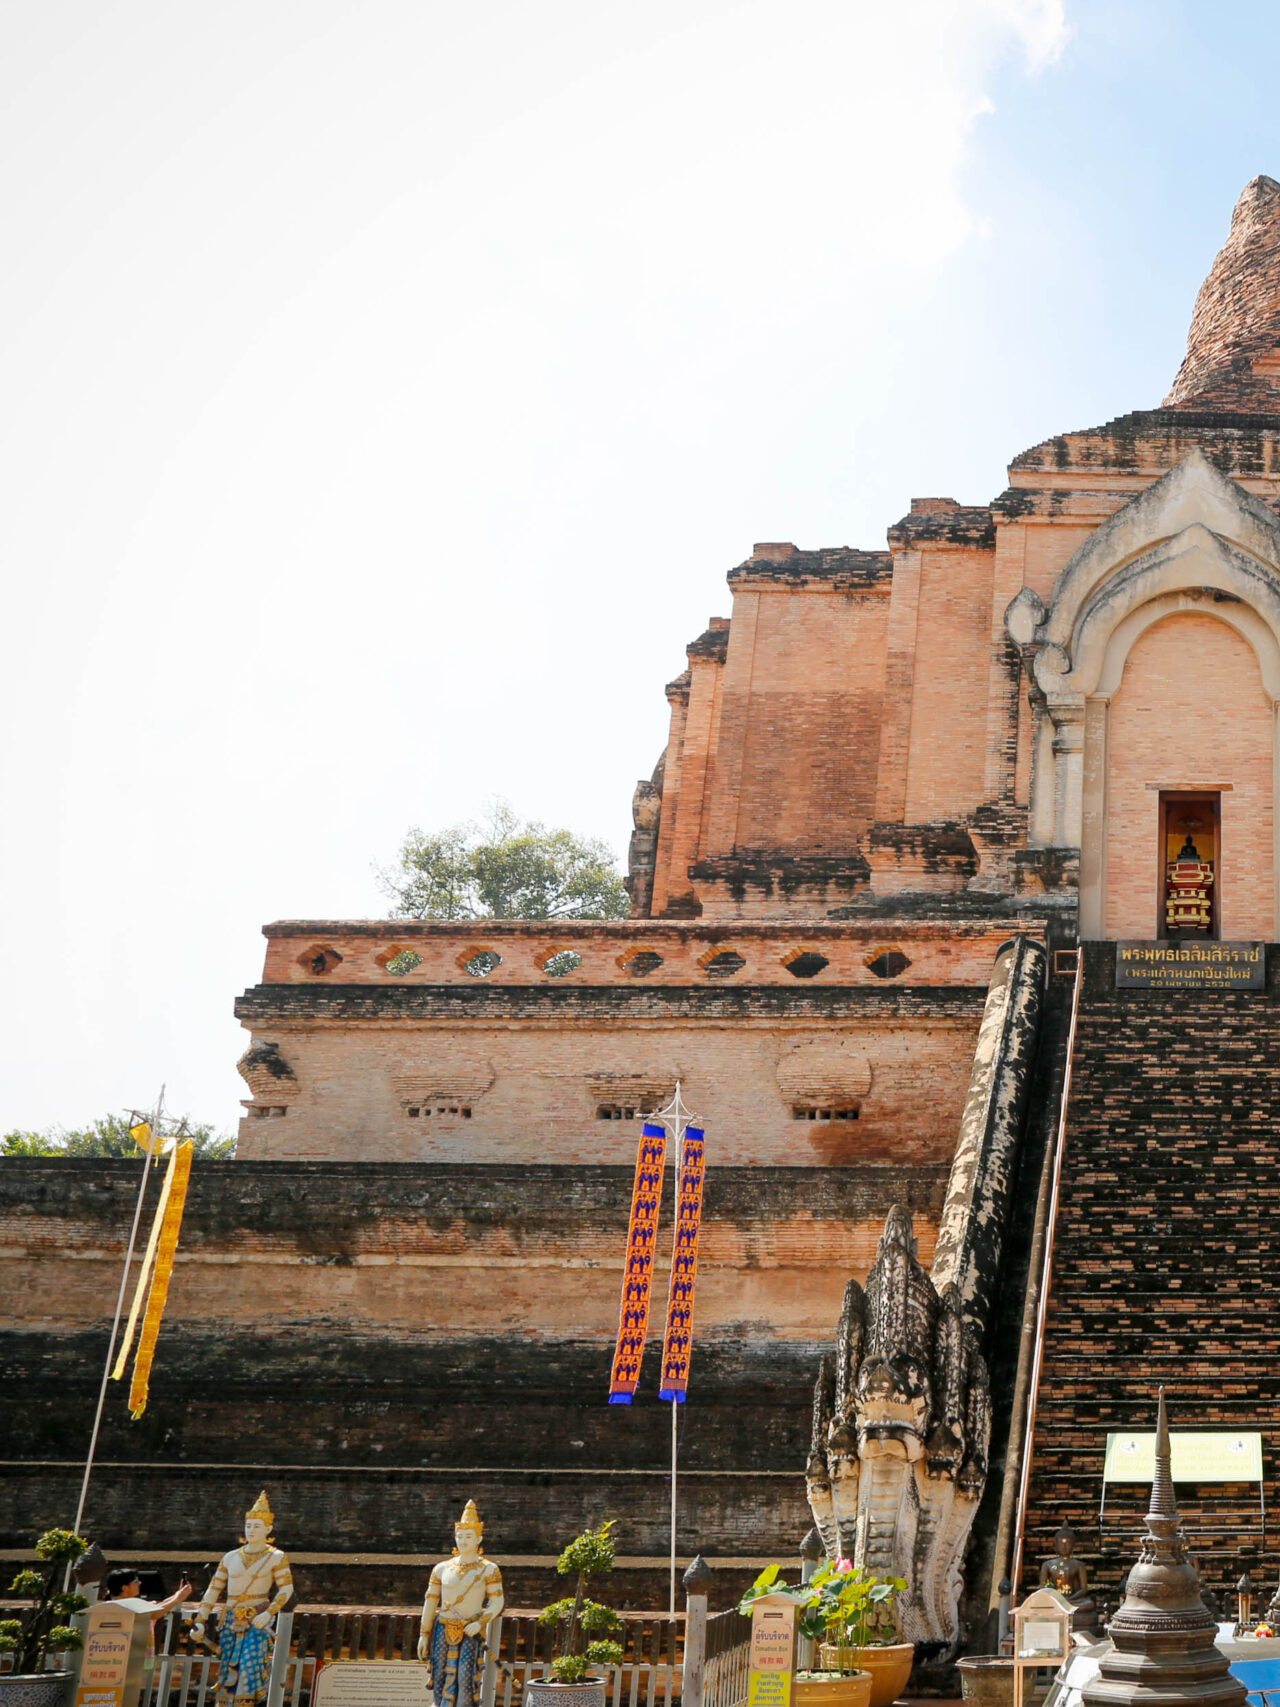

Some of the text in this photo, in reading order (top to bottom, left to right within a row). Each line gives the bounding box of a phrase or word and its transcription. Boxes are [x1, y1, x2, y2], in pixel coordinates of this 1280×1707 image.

[756, 1628, 789, 1644] ตู้รับบริจาค
